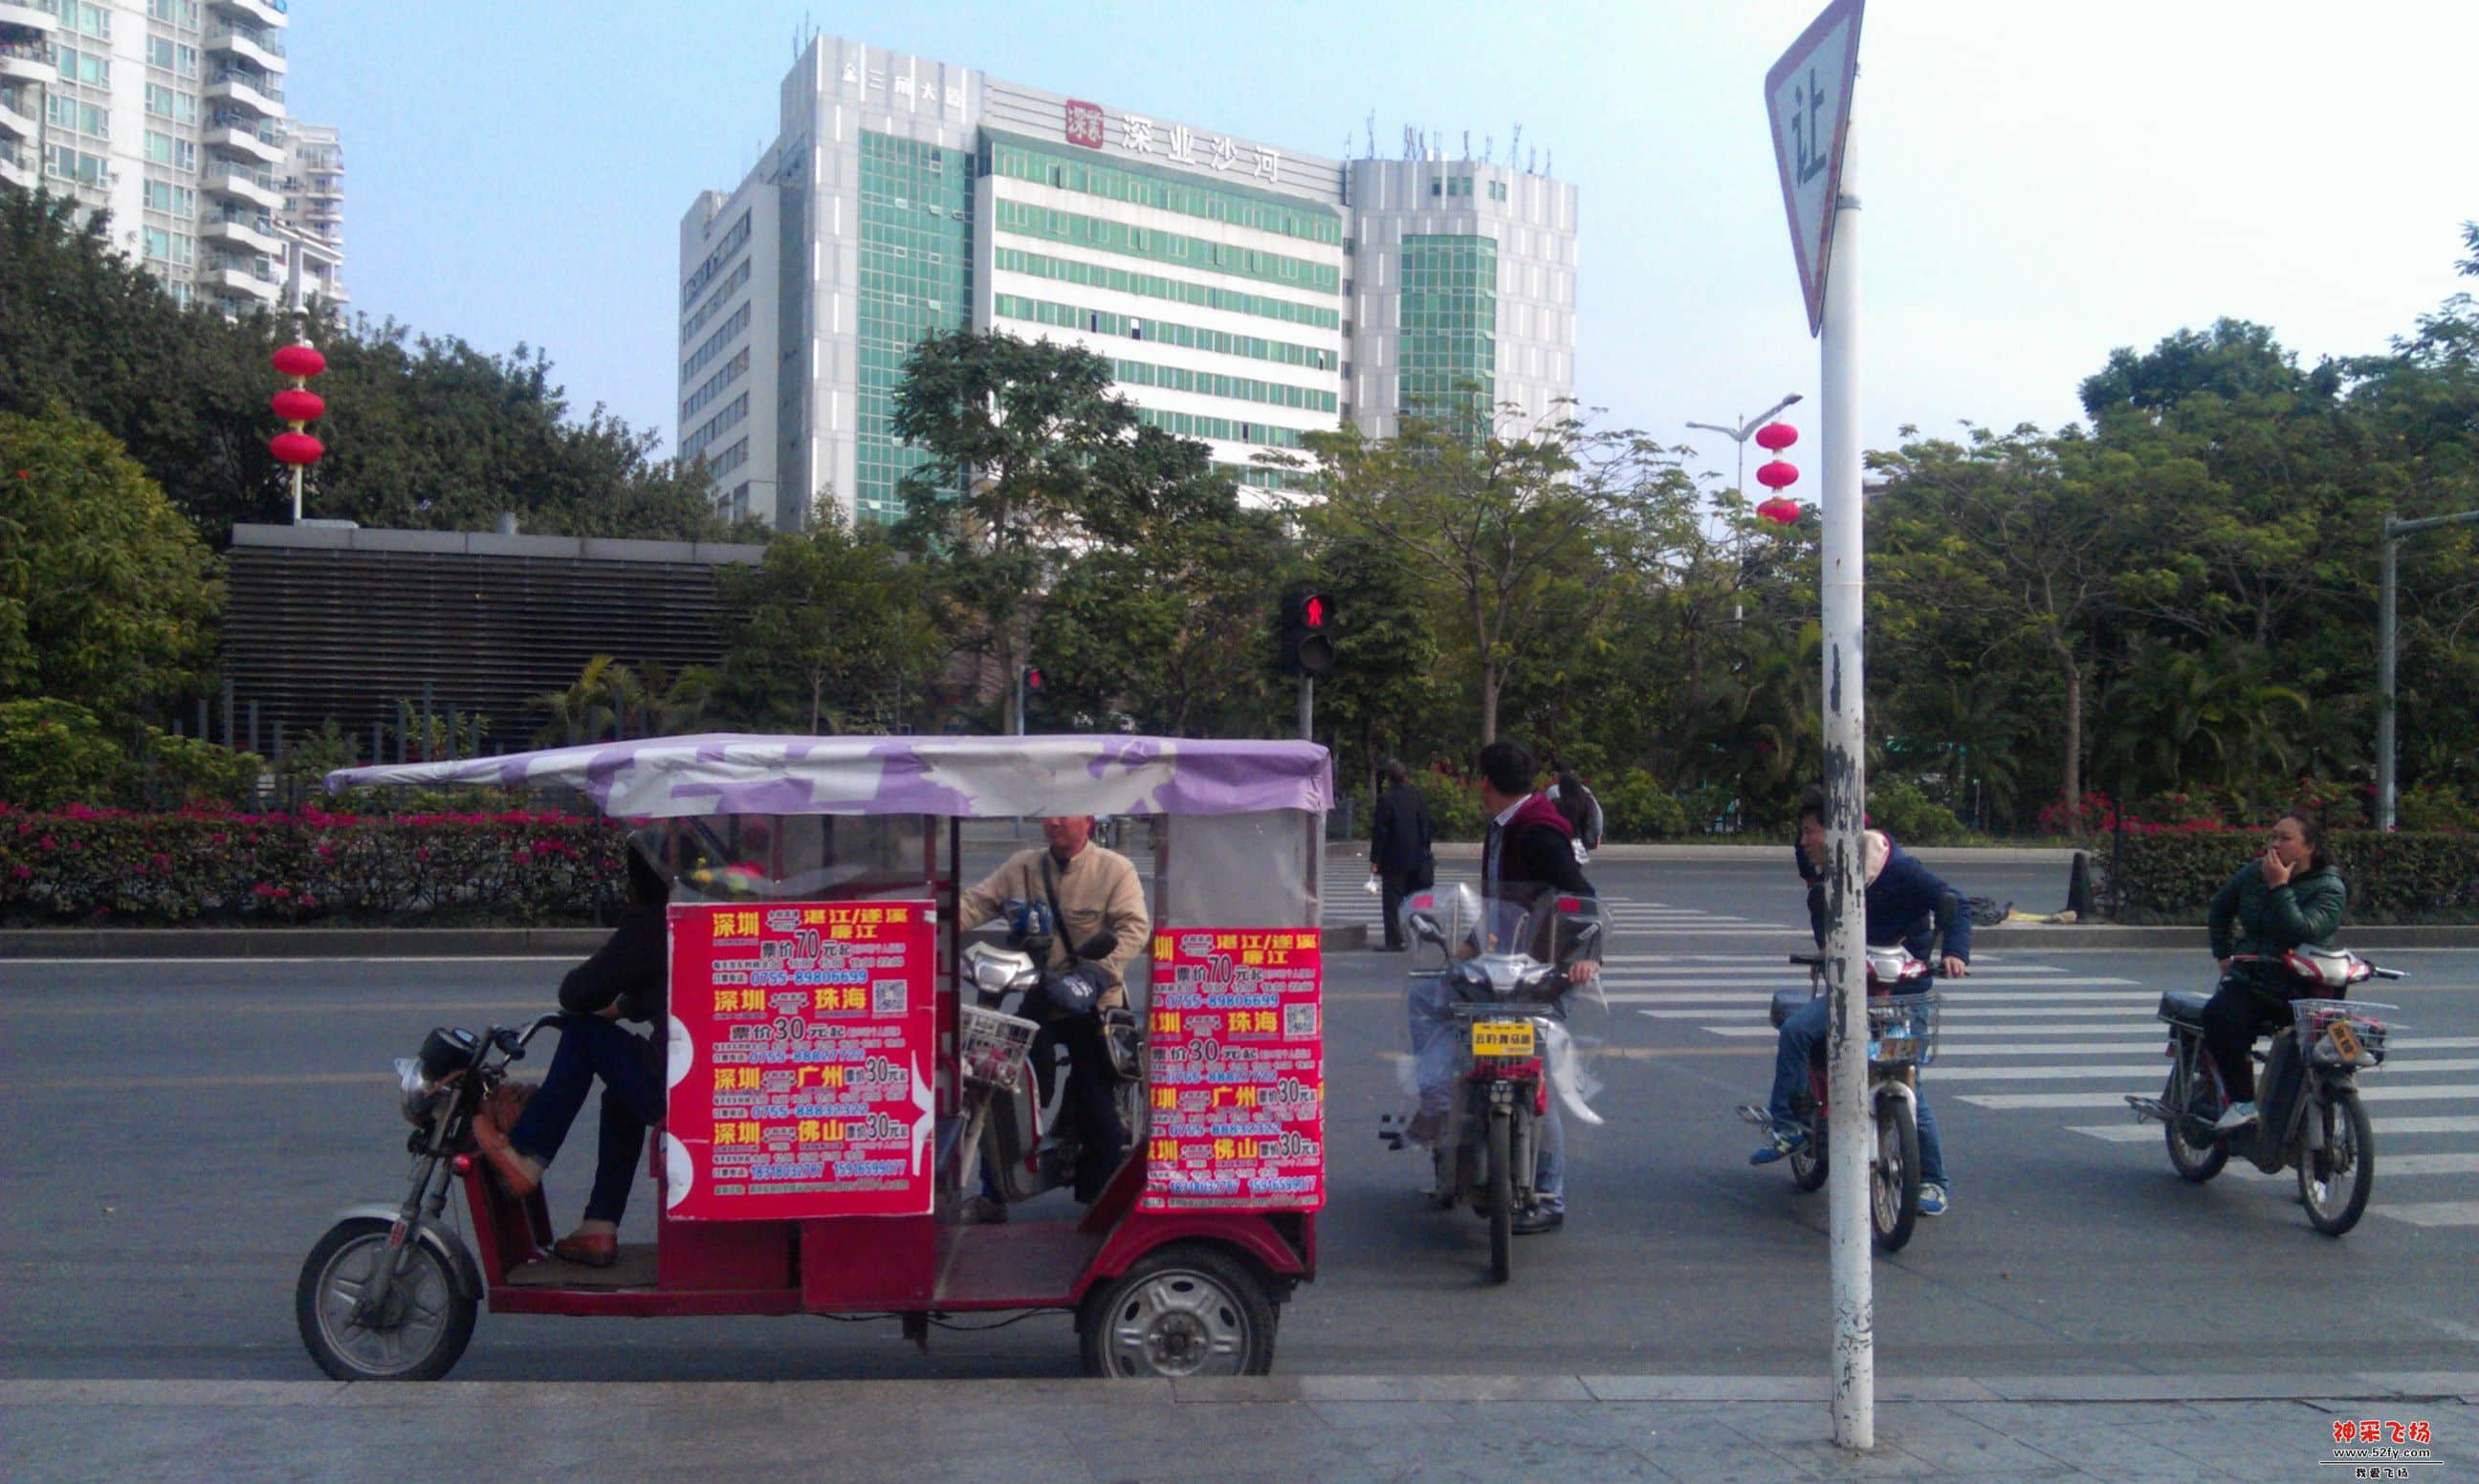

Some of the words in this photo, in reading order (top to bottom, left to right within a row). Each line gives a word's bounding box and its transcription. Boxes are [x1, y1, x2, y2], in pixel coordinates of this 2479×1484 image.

[1791, 66, 1827, 188] 让
[1121, 113, 1282, 185] 深业沙河
[713, 912, 759, 938] 深圳
[714, 990, 765, 1012] 深圳
[814, 989, 867, 1011] 珠海
[1228, 1011, 1278, 1034] 珠海
[714, 1068, 760, 1089] 深圳
[798, 1066, 843, 1088] 广州
[1212, 1086, 1257, 1108] 广州
[714, 1123, 760, 1145] 深圳
[798, 1121, 844, 1143] 佛山
[1214, 1138, 1258, 1160] 佛山
